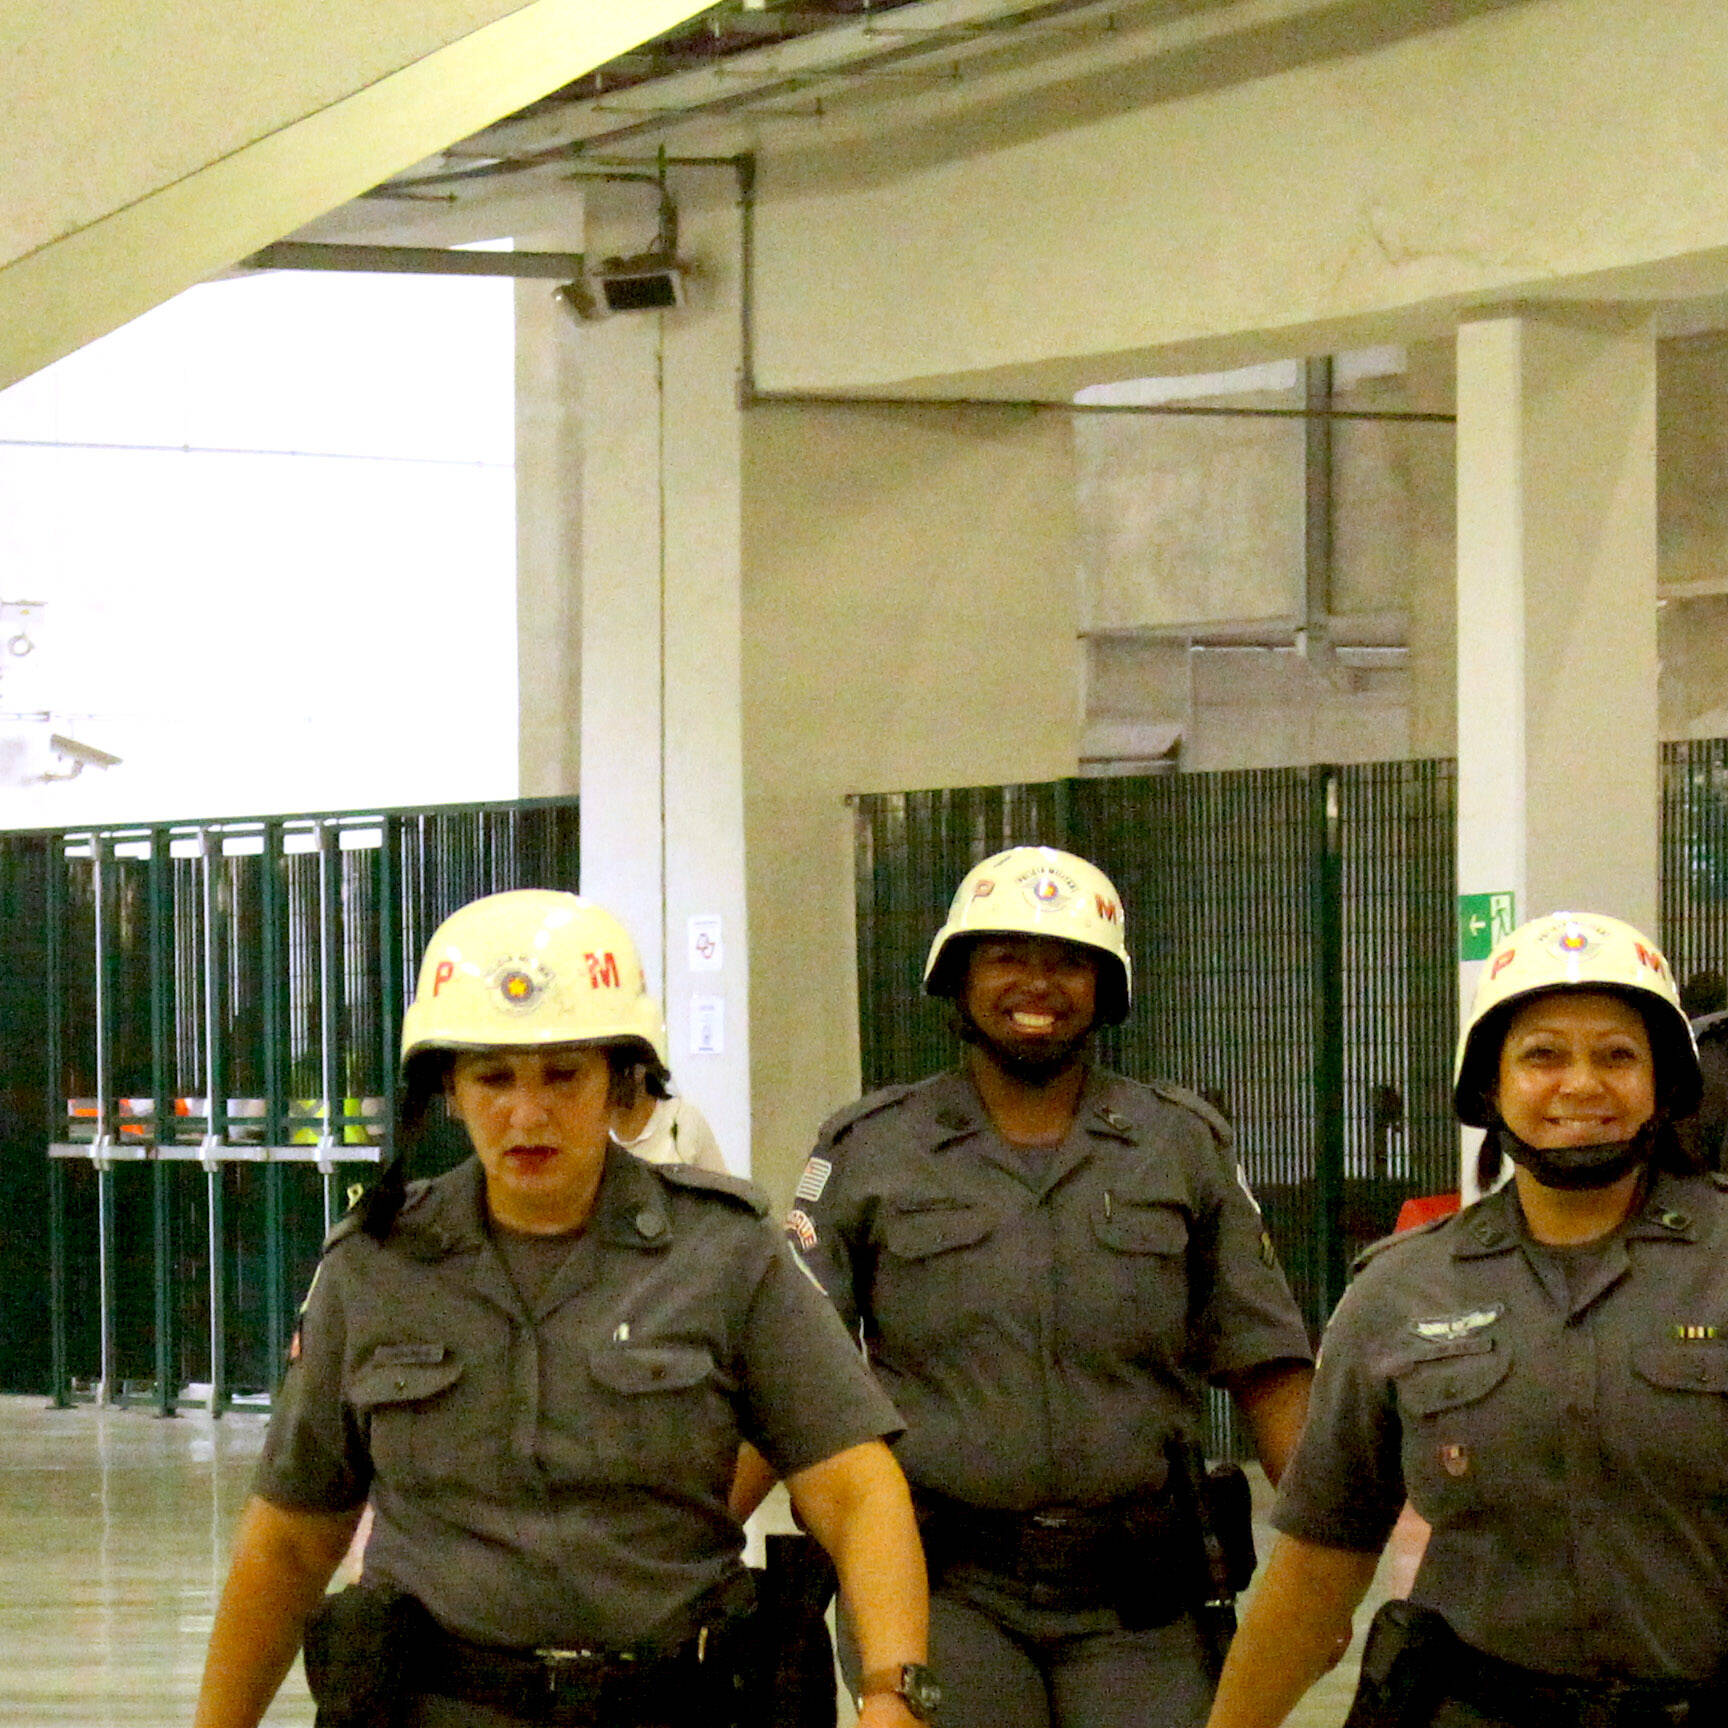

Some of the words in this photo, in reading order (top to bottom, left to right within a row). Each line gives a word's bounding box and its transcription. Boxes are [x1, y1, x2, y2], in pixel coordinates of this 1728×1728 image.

[972, 879, 996, 902] P
[1095, 892, 1118, 925] M
[433, 961, 454, 998] P
[584, 952, 621, 990] M
[1490, 948, 1515, 981] P
[1634, 942, 1666, 980] M
